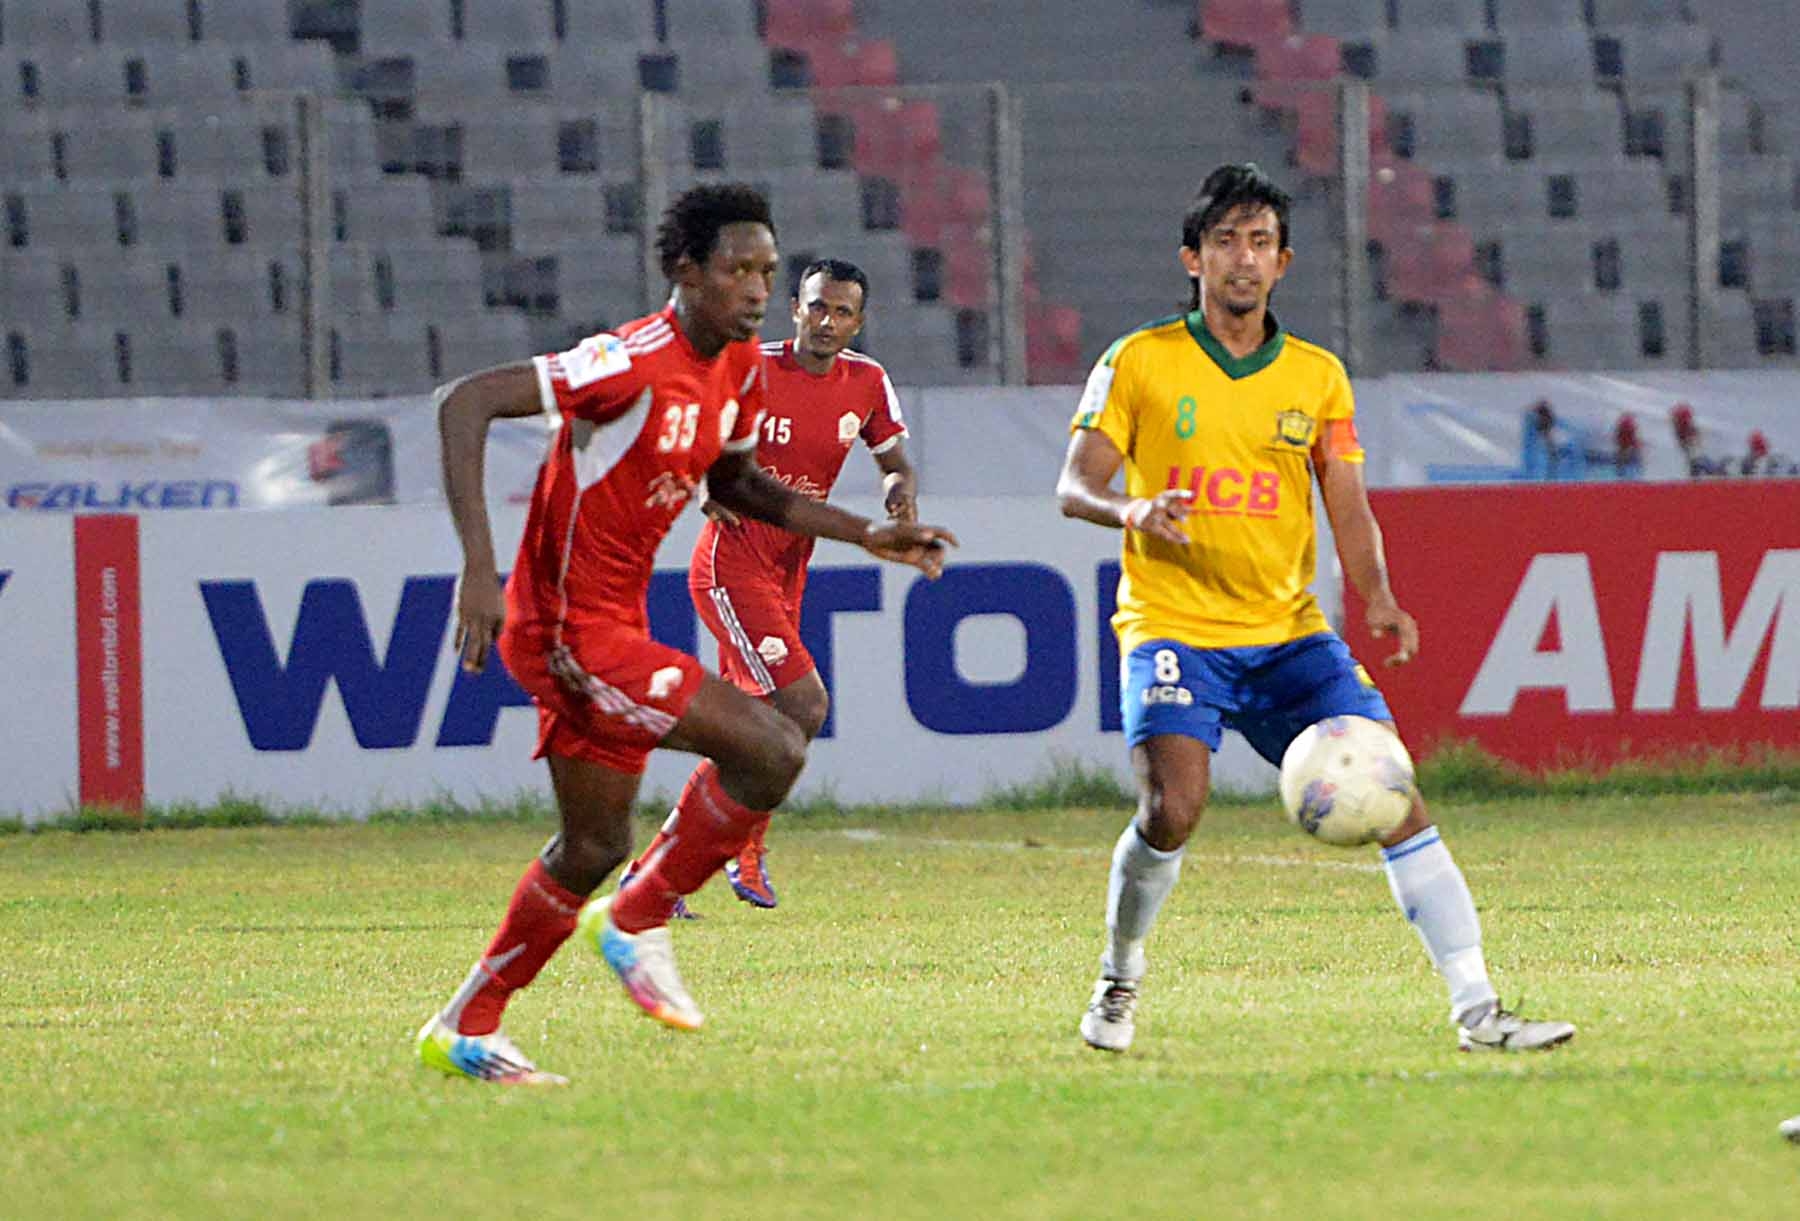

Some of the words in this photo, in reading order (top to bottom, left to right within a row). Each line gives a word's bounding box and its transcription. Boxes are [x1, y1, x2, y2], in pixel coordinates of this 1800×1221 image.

[657, 403, 700, 451] 35
[764, 415, 792, 444] 15
[1175, 395, 1197, 440] 8
[1154, 649, 1181, 682] 8
